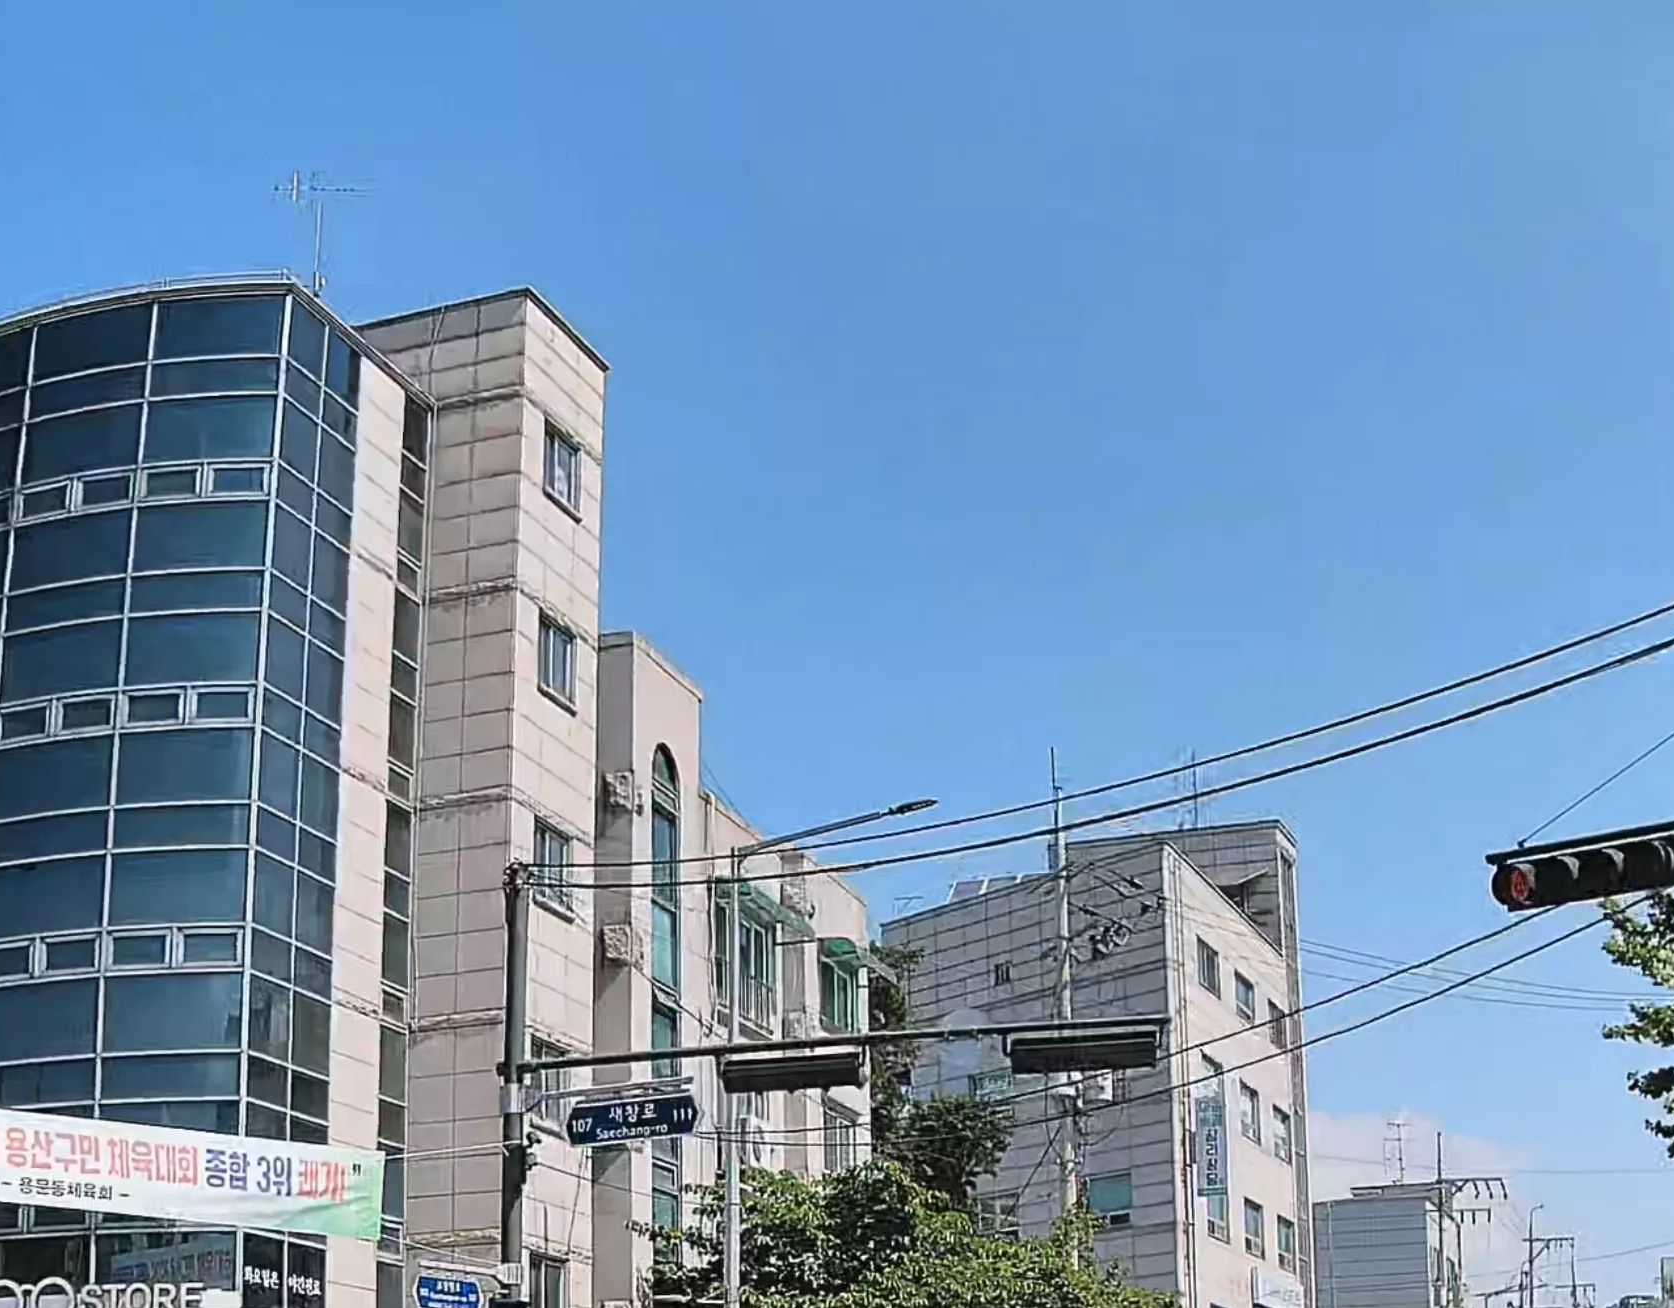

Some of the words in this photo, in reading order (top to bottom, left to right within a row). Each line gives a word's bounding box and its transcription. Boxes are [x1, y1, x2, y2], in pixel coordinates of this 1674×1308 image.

[609, 1104, 657, 1123] 새창로
[673, 1108, 693, 1122] 111
[572, 1118, 593, 1132] 107
[596, 1124, 668, 1140] Saechang-ro
[6, 1127, 101, 1174] 용산구민
[108, 1137, 199, 1186] 체육대회
[205, 1148, 251, 1192] 종합
[256, 1155, 292, 1197] 3위
[18, 1176, 113, 1202] 용문동체육회
